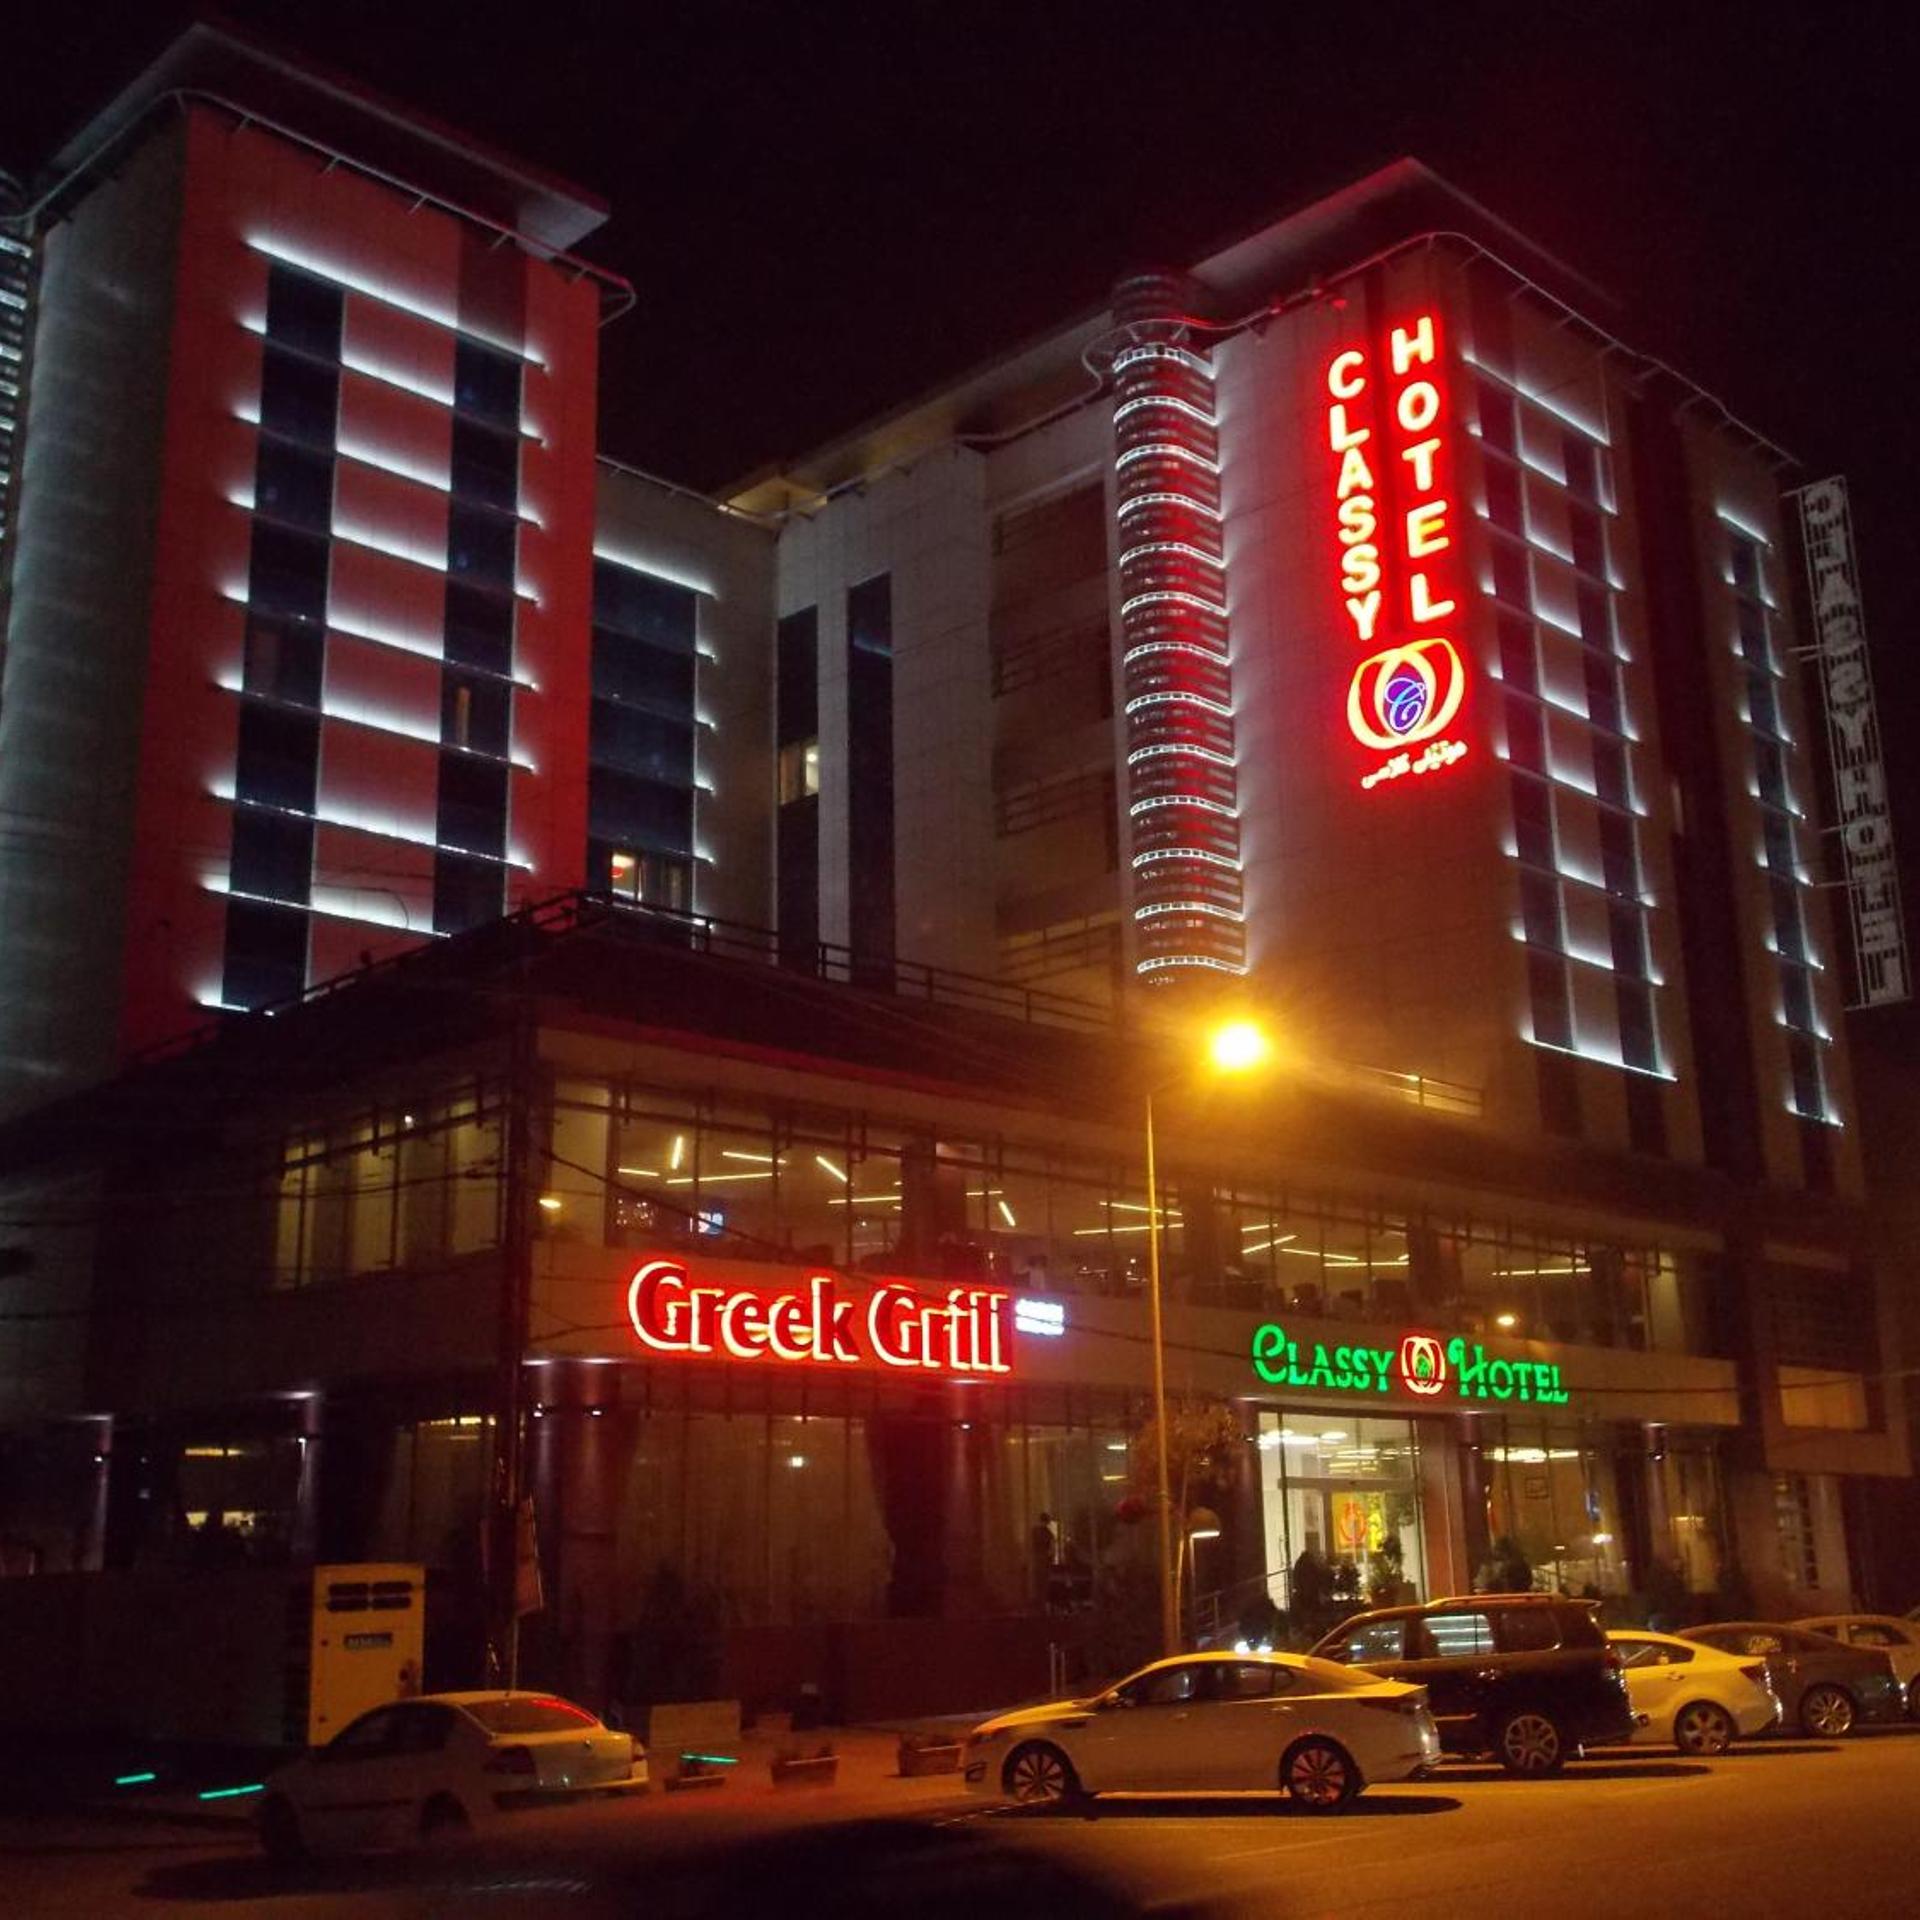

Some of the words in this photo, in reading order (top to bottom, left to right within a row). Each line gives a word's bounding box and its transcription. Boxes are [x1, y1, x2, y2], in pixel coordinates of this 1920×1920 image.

[1328, 350, 1381, 641] CLASSY
[1391, 315, 1455, 622] HOTEL
[628, 1261, 861, 1363] Greek
[867, 1284, 1011, 1373] Grill
[1252, 1323, 1396, 1393] CLASSY
[1446, 1336, 1569, 1404] HOTEL
